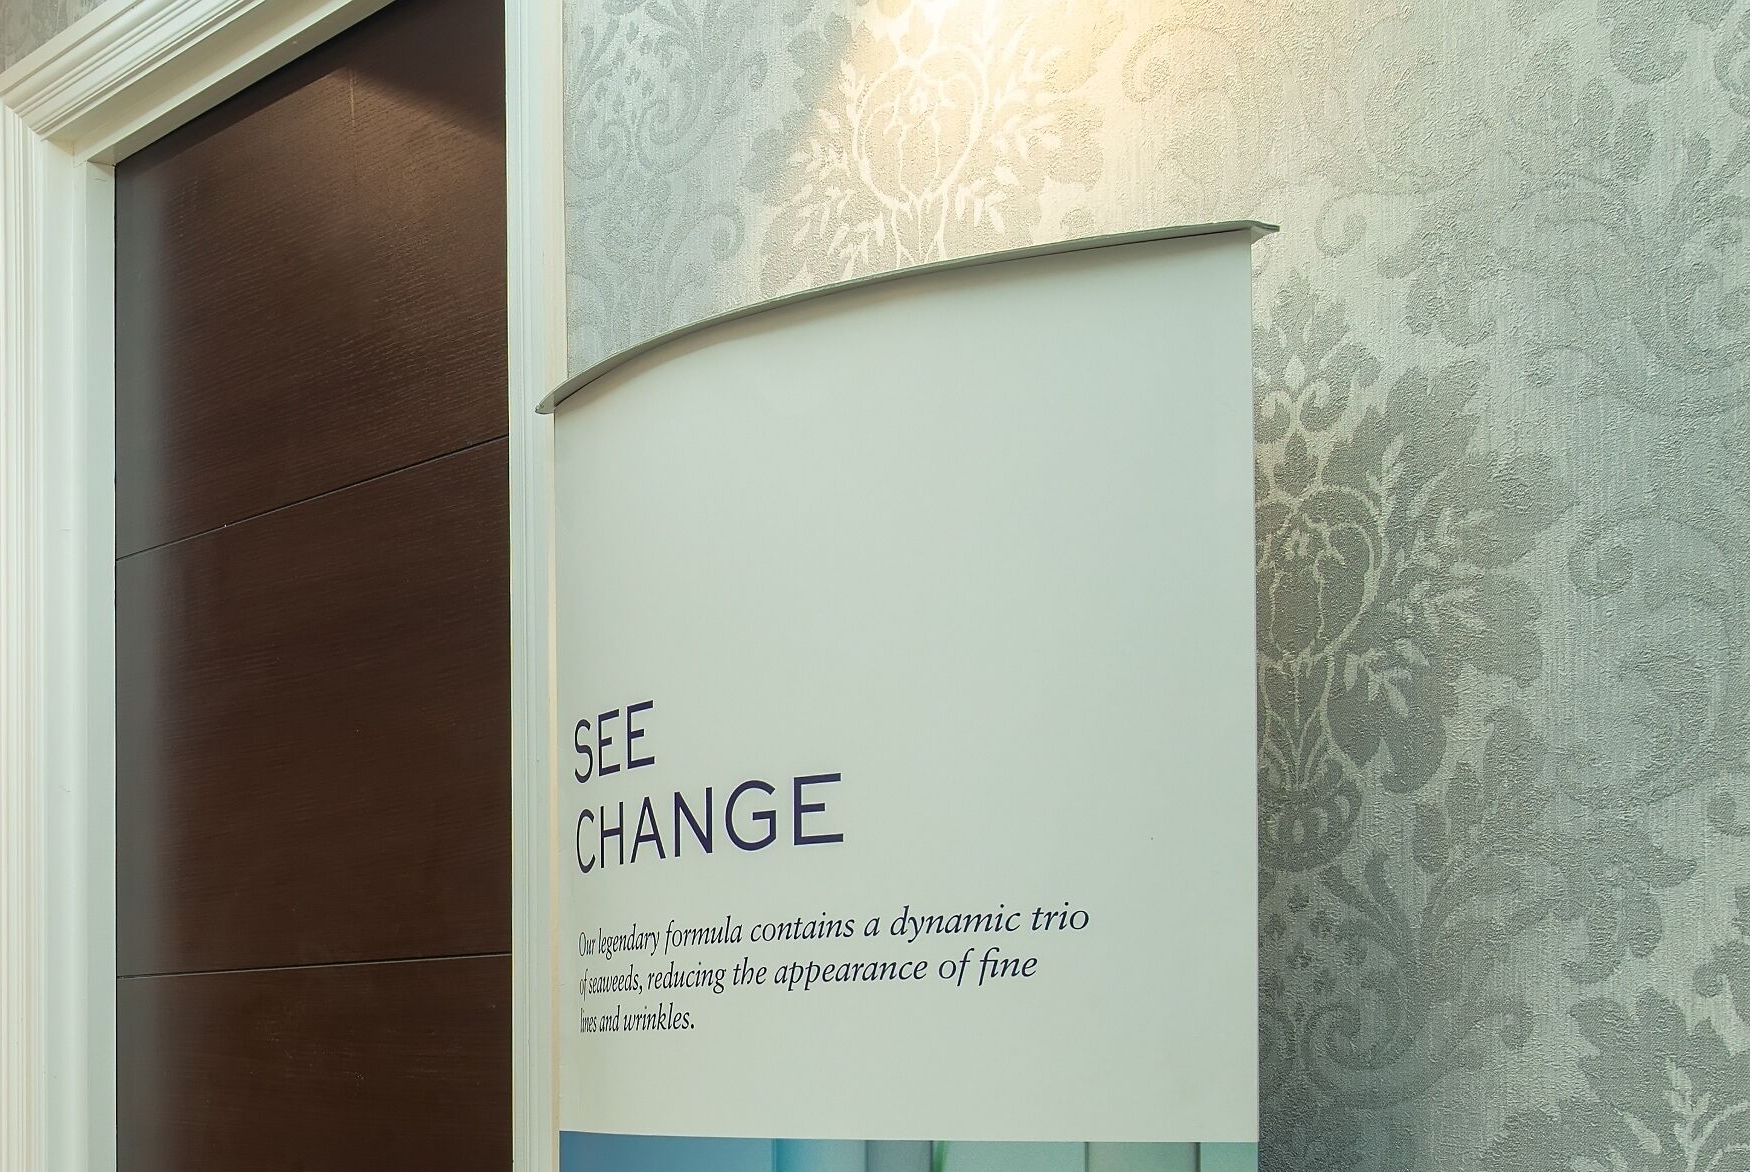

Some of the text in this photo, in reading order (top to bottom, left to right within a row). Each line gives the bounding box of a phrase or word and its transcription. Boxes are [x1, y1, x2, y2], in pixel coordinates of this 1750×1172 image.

[574, 700, 655, 784] SEE
[576, 772, 844, 873] CHANGE
[578, 901, 1090, 960] Our legendary formula contains a dynamic trio
[579, 946, 1038, 1001] of seaweeds, reducing the appearance of fine
[580, 1002, 695, 1033] lines and wrinkles.
